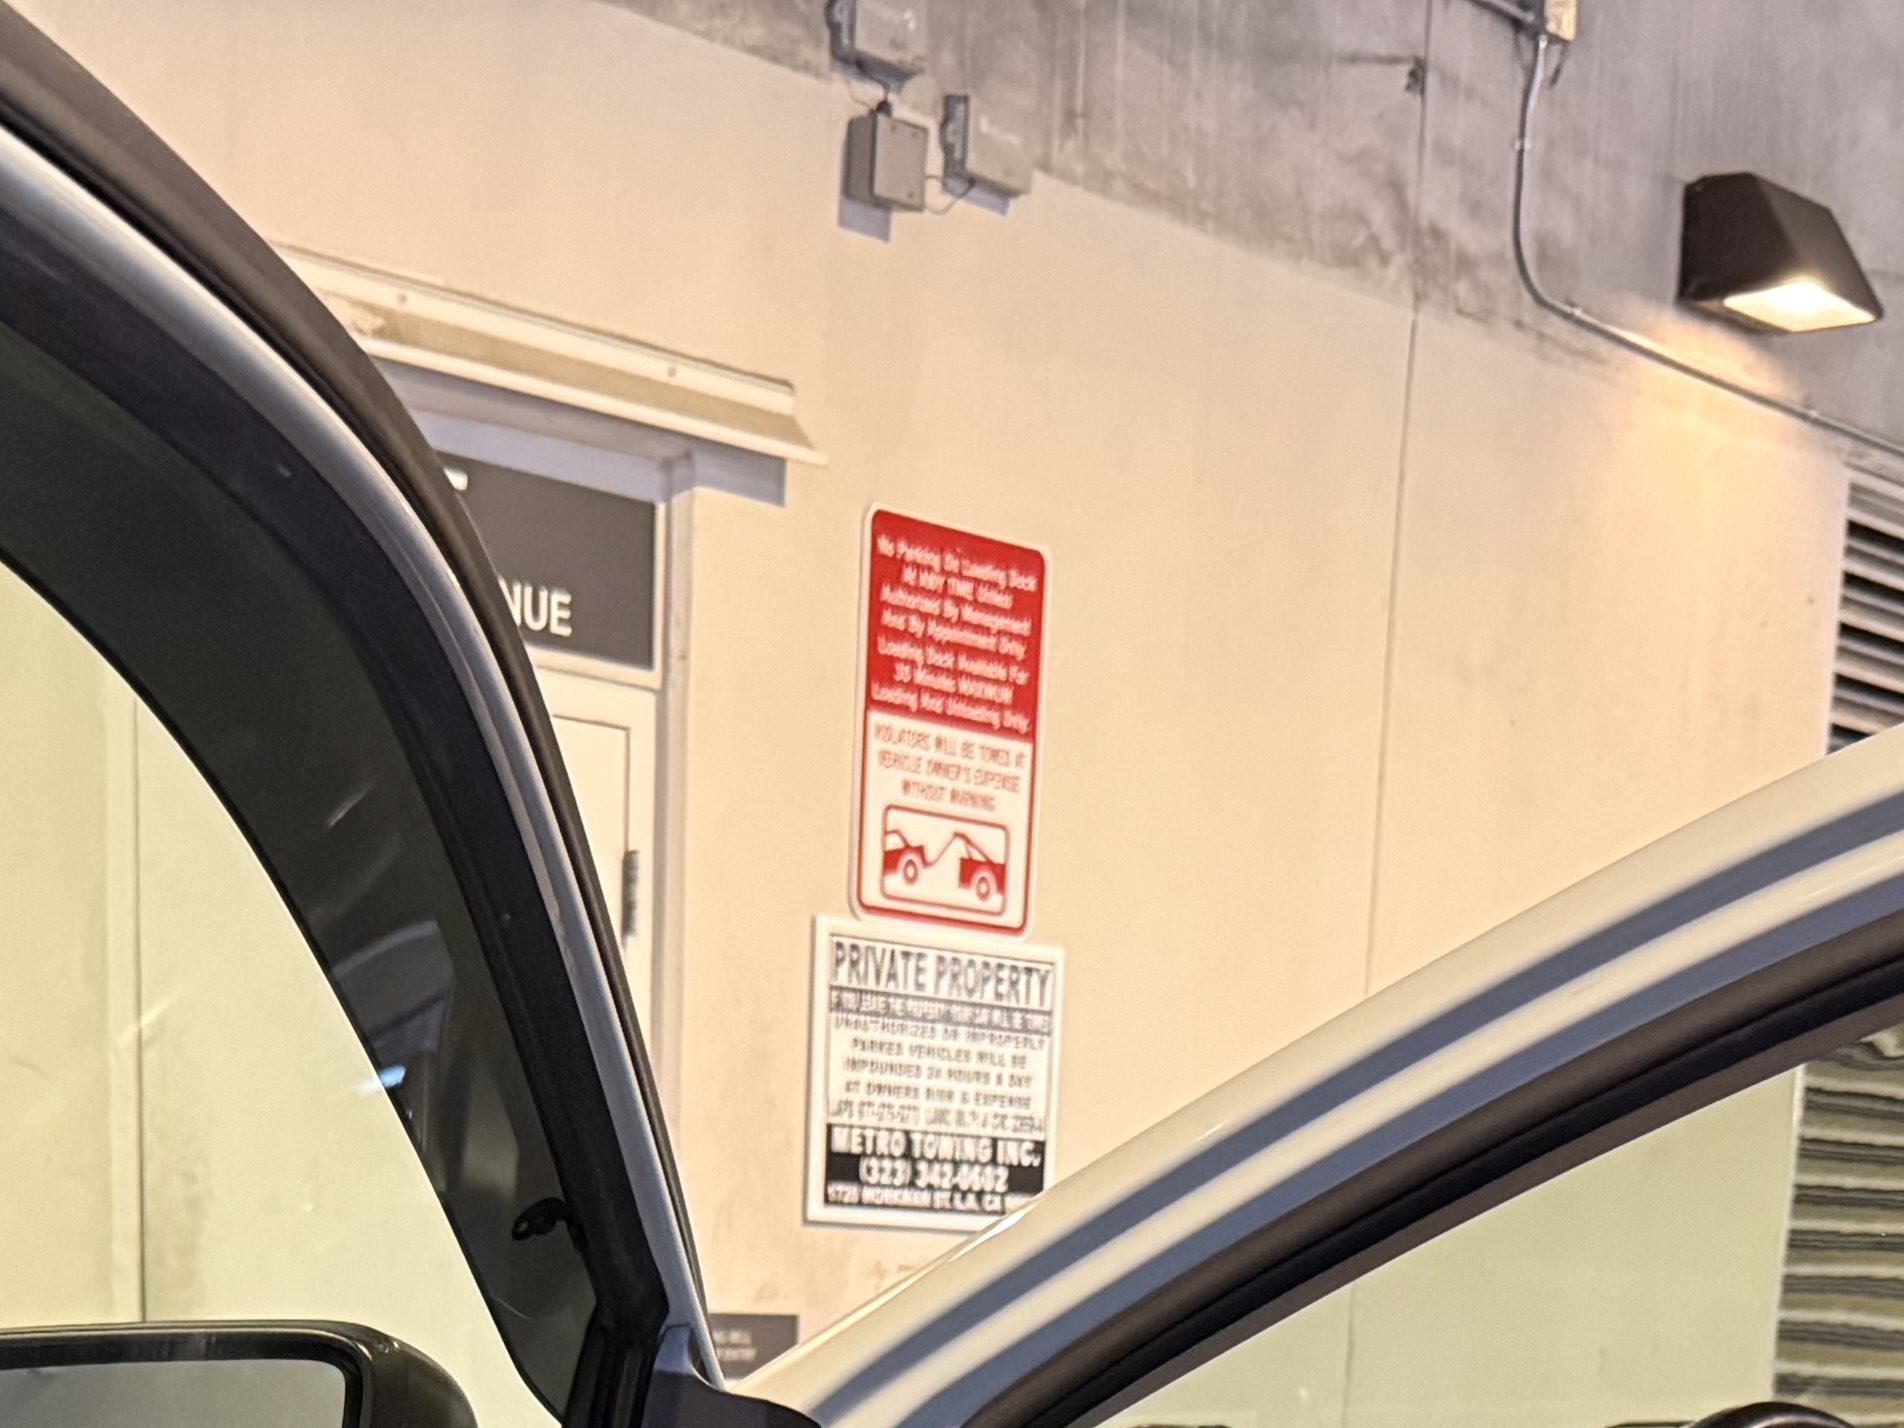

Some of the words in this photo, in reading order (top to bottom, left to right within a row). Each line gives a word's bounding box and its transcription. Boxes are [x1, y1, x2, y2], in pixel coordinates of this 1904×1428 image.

[896, 540, 940, 572] Parking
[961, 558, 1007, 589] Loading
[834, 941, 927, 992] PRIVATE
[935, 955, 1050, 1007] PROPERTY
[853, 1037, 902, 1055] PARKED
[909, 1044, 970, 1063] VEHICLES
[976, 1051, 1005, 1066] WILL
[846, 1057, 921, 1078] IMPOUNDED
[948, 1068, 989, 1085] HOURS
[975, 1092, 1030, 1110] EXPENSE
[831, 1125, 905, 1156] METRO
[911, 1132, 992, 1163] TOWING
[859, 1155, 910, 1186] (323)
